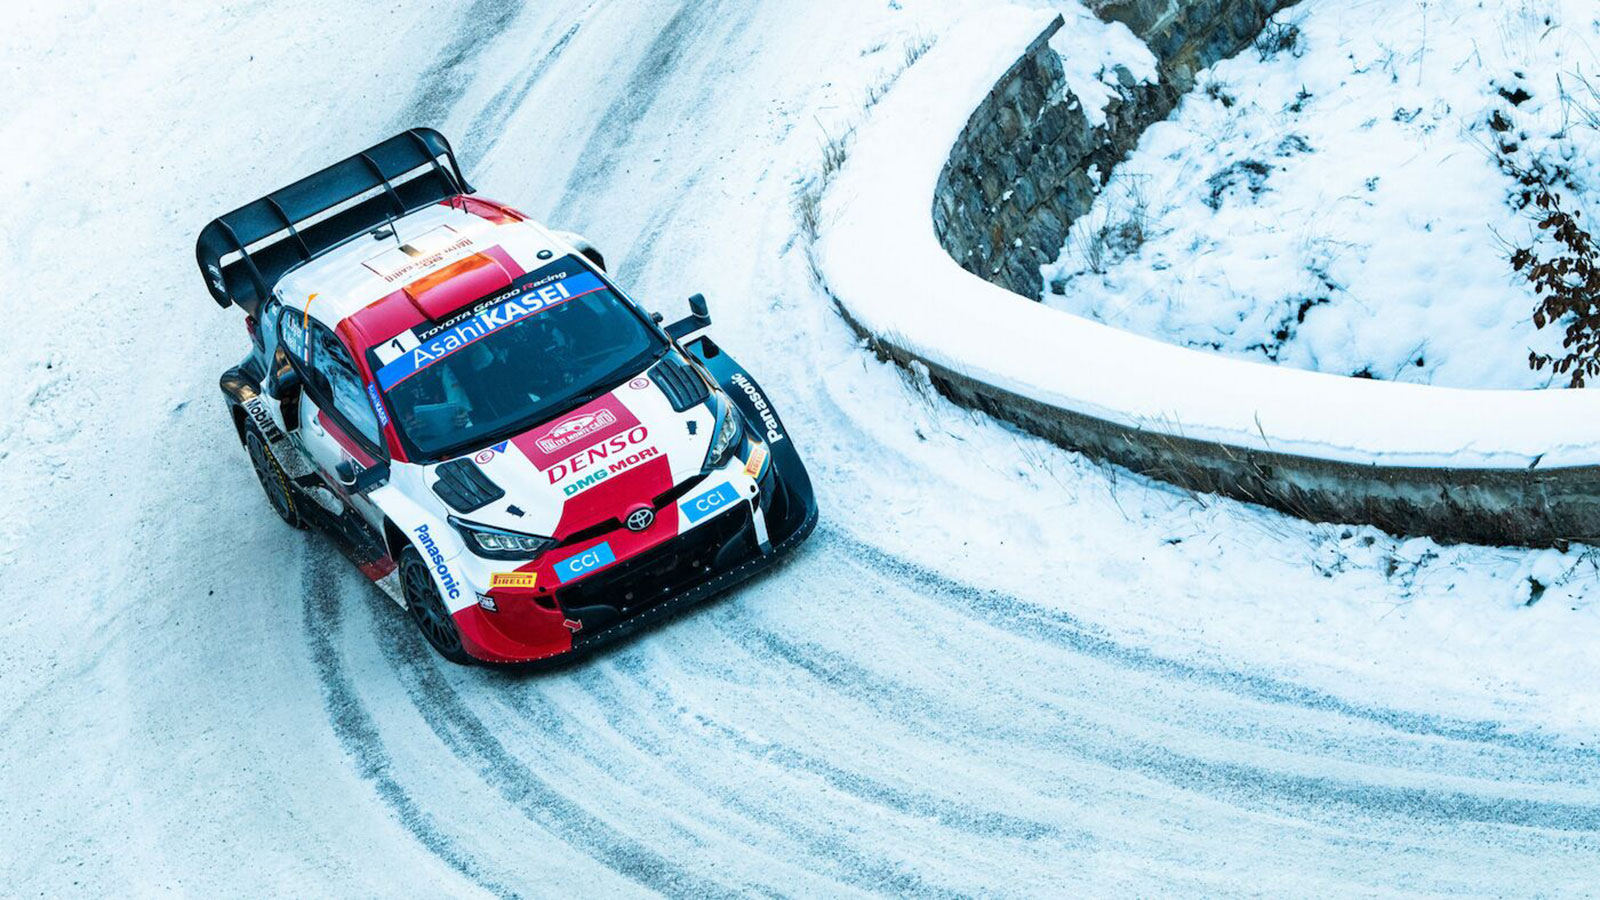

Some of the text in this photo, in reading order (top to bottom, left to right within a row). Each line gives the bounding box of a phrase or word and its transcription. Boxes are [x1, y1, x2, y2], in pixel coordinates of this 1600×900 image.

[418, 271, 567, 340] TOYOTA GAZOO Racing
[391, 338, 406, 354] 1
[244, 398, 276, 431] Mobil
[731, 373, 783, 444] Panasonic
[540, 435, 568, 453] RALLYE
[547, 426, 648, 485] DENSO
[563, 446, 659, 496] DMG MORI
[413, 524, 461, 600] Panasonic
[493, 574, 533, 585] PIRELLI
